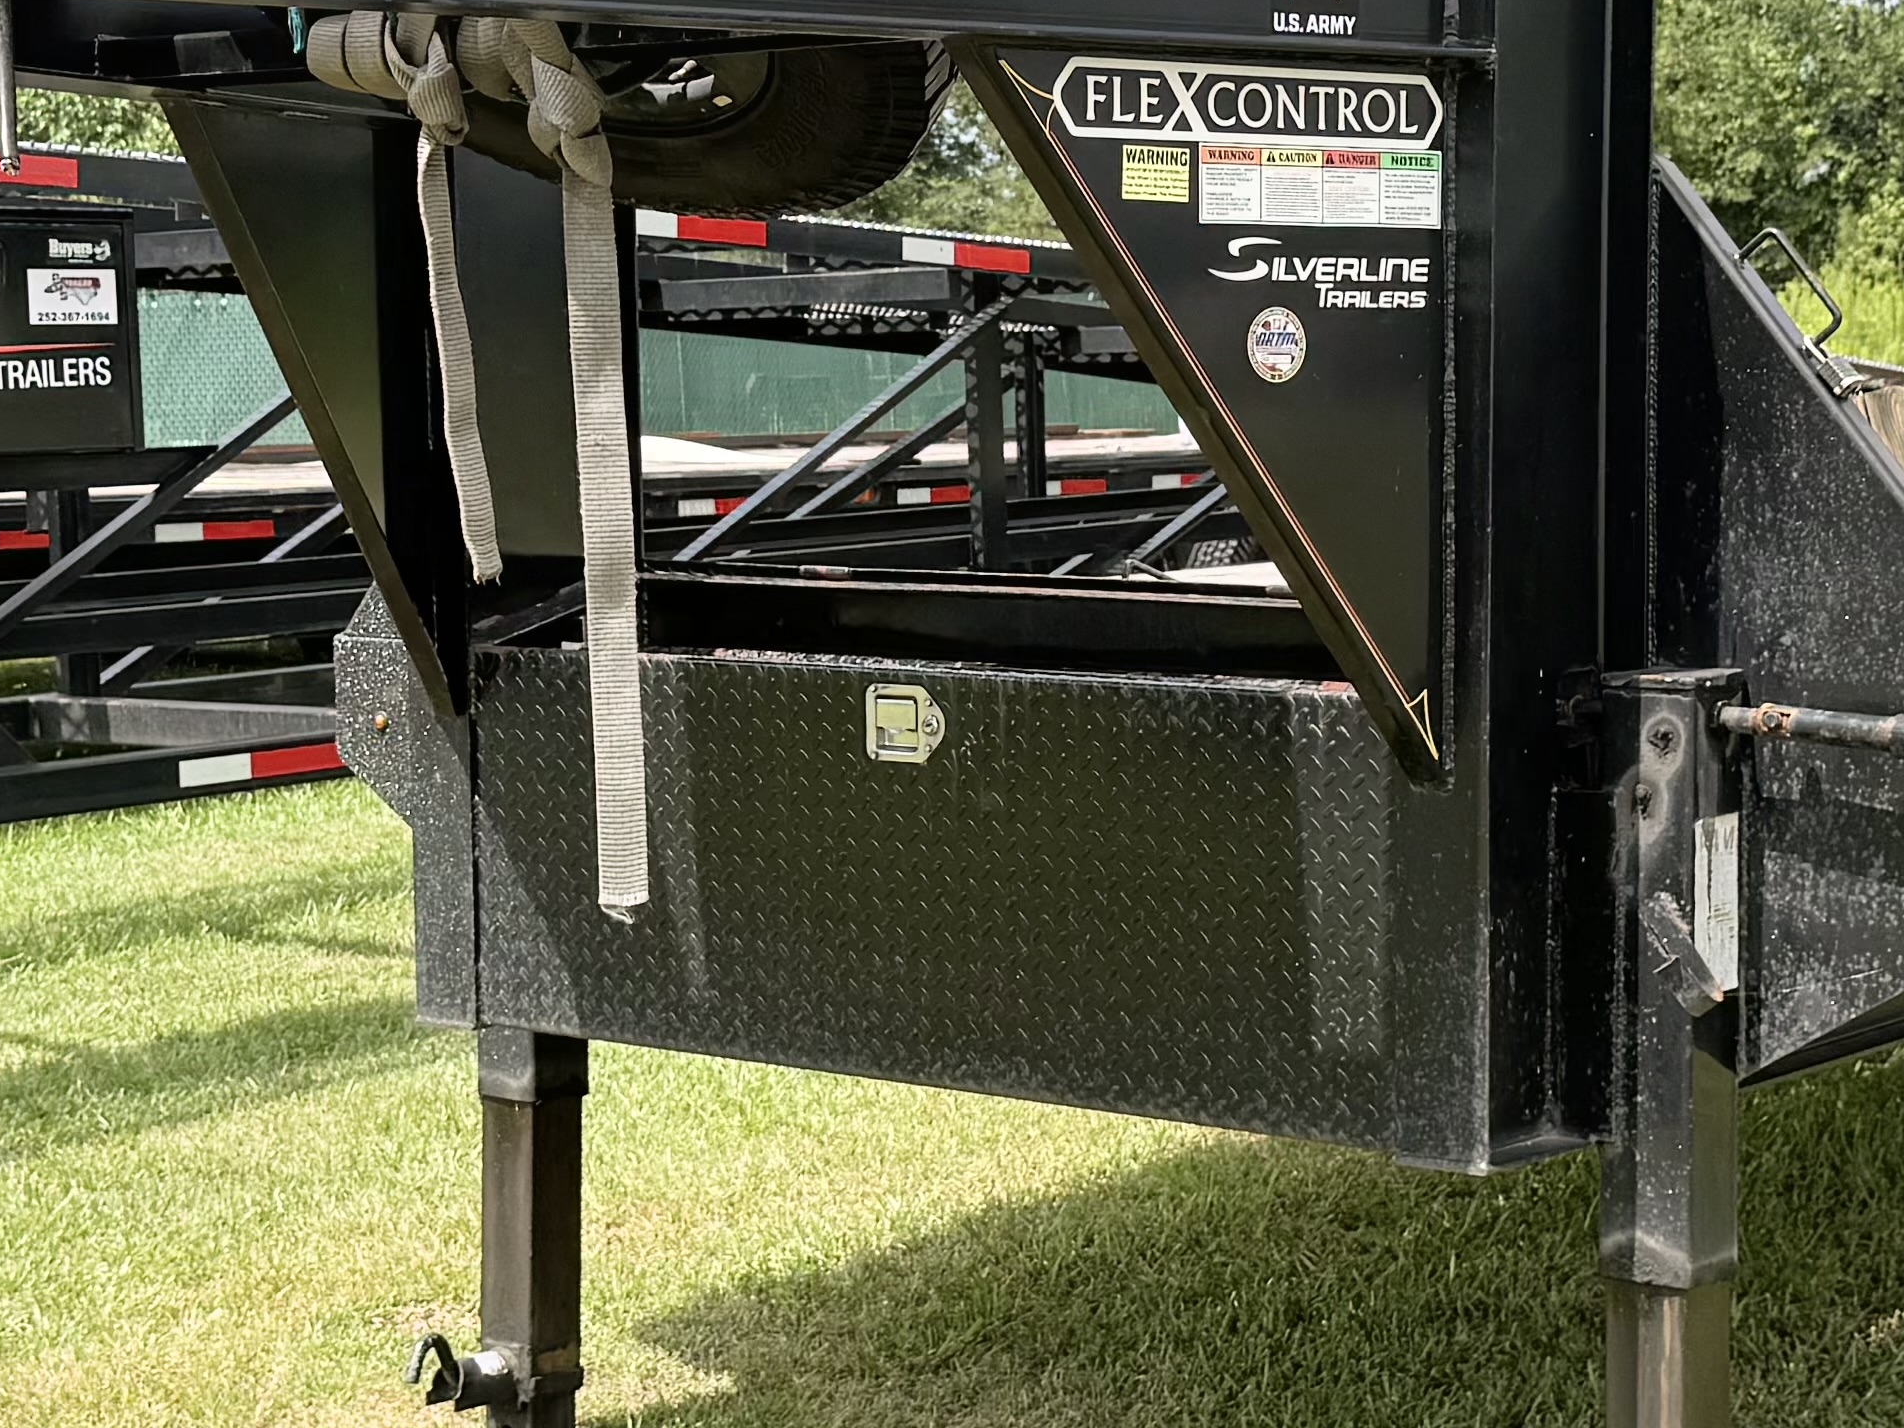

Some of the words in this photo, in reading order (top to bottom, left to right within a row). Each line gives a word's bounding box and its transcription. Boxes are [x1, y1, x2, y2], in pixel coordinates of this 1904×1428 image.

[1273, 12, 1304, 34] U.S.
[1306, 14, 1356, 36] ARMY
[1126, 147, 1188, 167] WARNING
[1208, 149, 1255, 161] WARNING
[1279, 152, 1317, 163] CAUTION
[1391, 155, 1434, 167] NOTICE
[1207, 236, 1430, 282] SILVERLINE
[1314, 282, 1428, 308] TRAILERS
